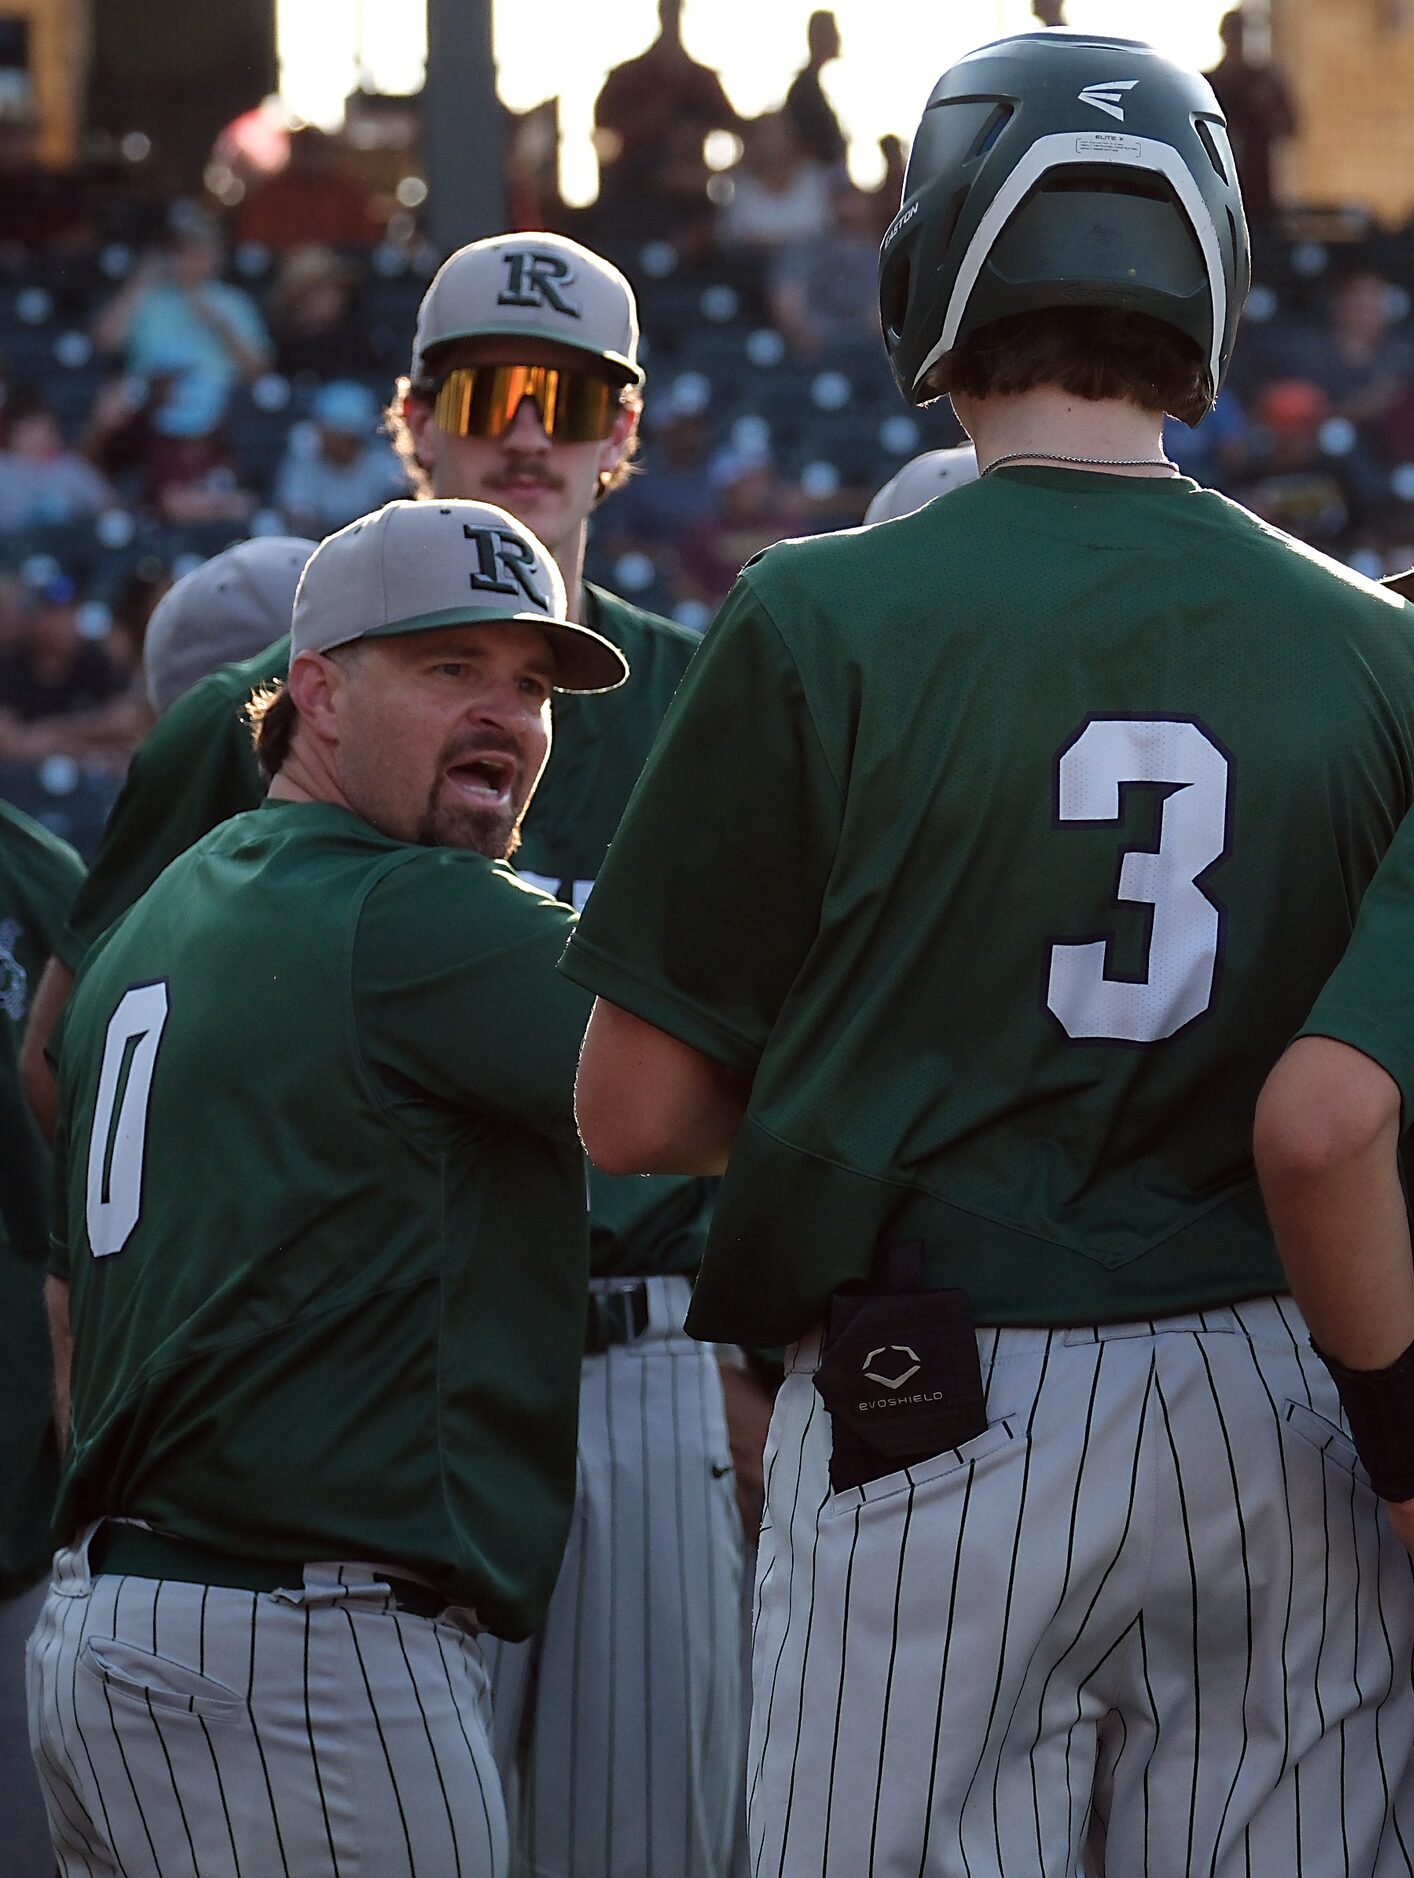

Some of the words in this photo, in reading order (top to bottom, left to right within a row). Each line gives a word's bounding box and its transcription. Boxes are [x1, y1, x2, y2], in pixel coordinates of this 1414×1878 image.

[884, 201, 919, 250] EASTON
[497, 252, 582, 319] R
[463, 523, 550, 612] R
[1045, 717, 1231, 1044] 3
[85, 981, 171, 1259] 0
